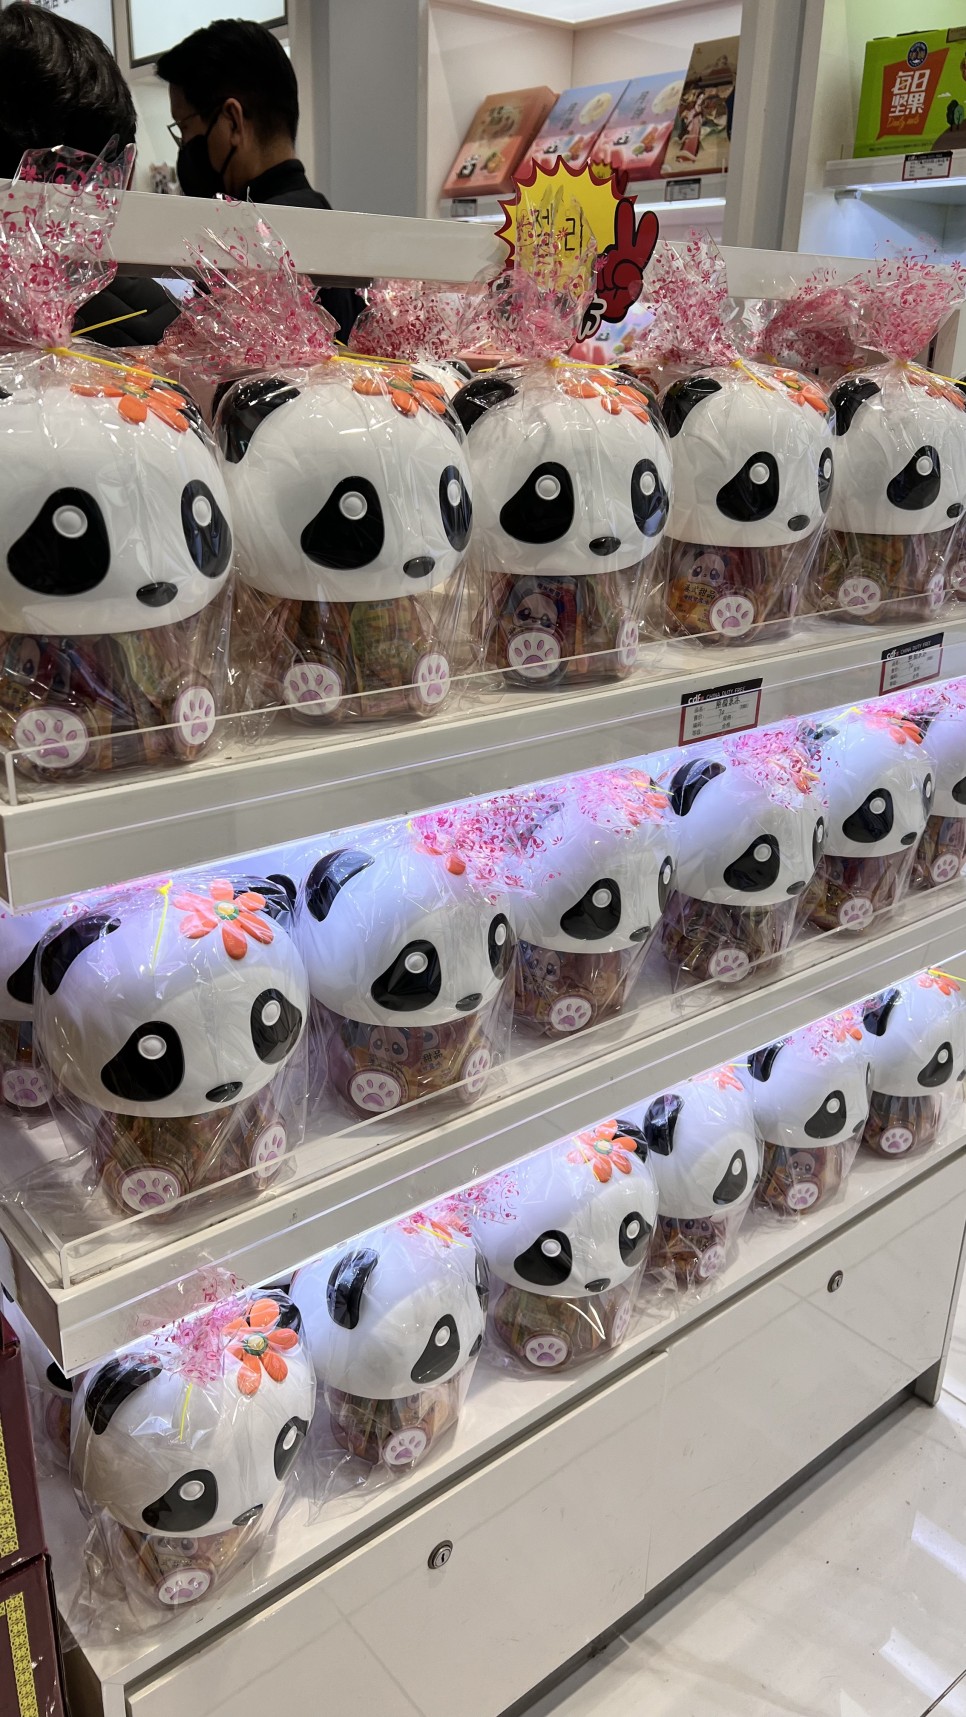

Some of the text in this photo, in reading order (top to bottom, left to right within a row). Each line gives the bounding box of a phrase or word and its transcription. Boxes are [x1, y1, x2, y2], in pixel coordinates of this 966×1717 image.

[891, 69, 931, 94] 每日
[889, 92, 925, 117] 坚果
[721, 688, 733, 696] DUTY
